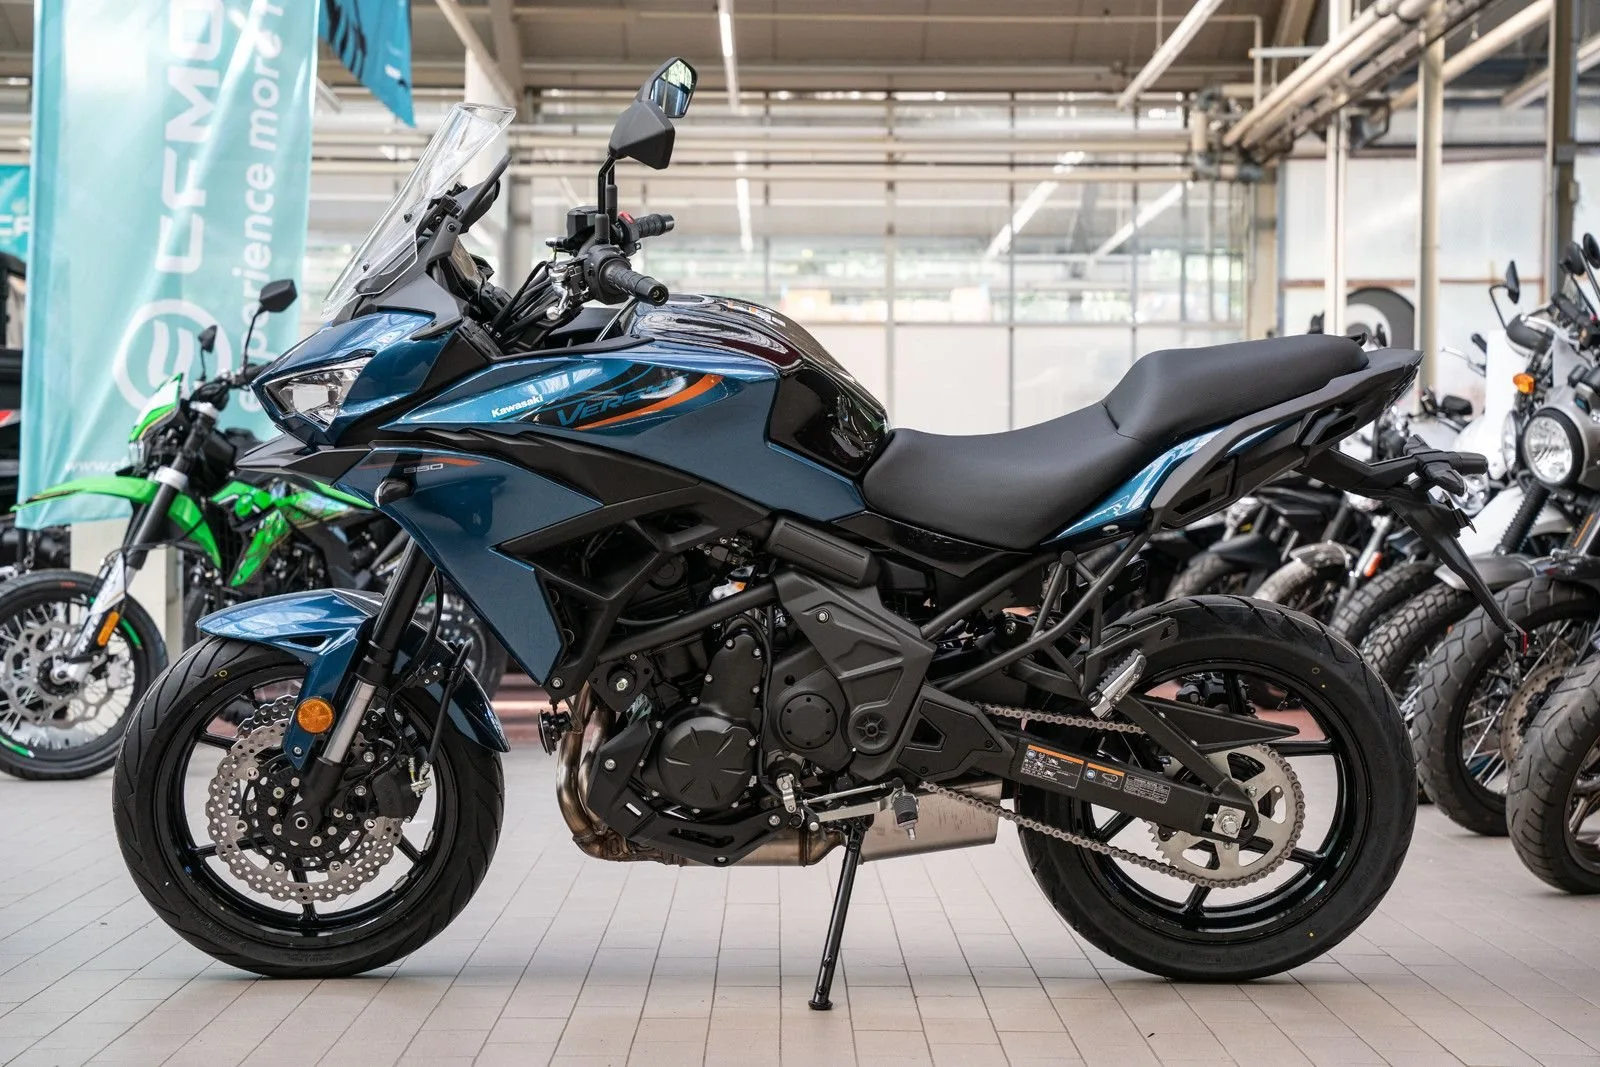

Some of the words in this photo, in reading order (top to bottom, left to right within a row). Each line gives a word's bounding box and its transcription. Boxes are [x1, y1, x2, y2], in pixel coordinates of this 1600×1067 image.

[248, 29, 282, 151] more
[232, 162, 279, 412] eperience
[491, 394, 544, 418] Kawasaki
